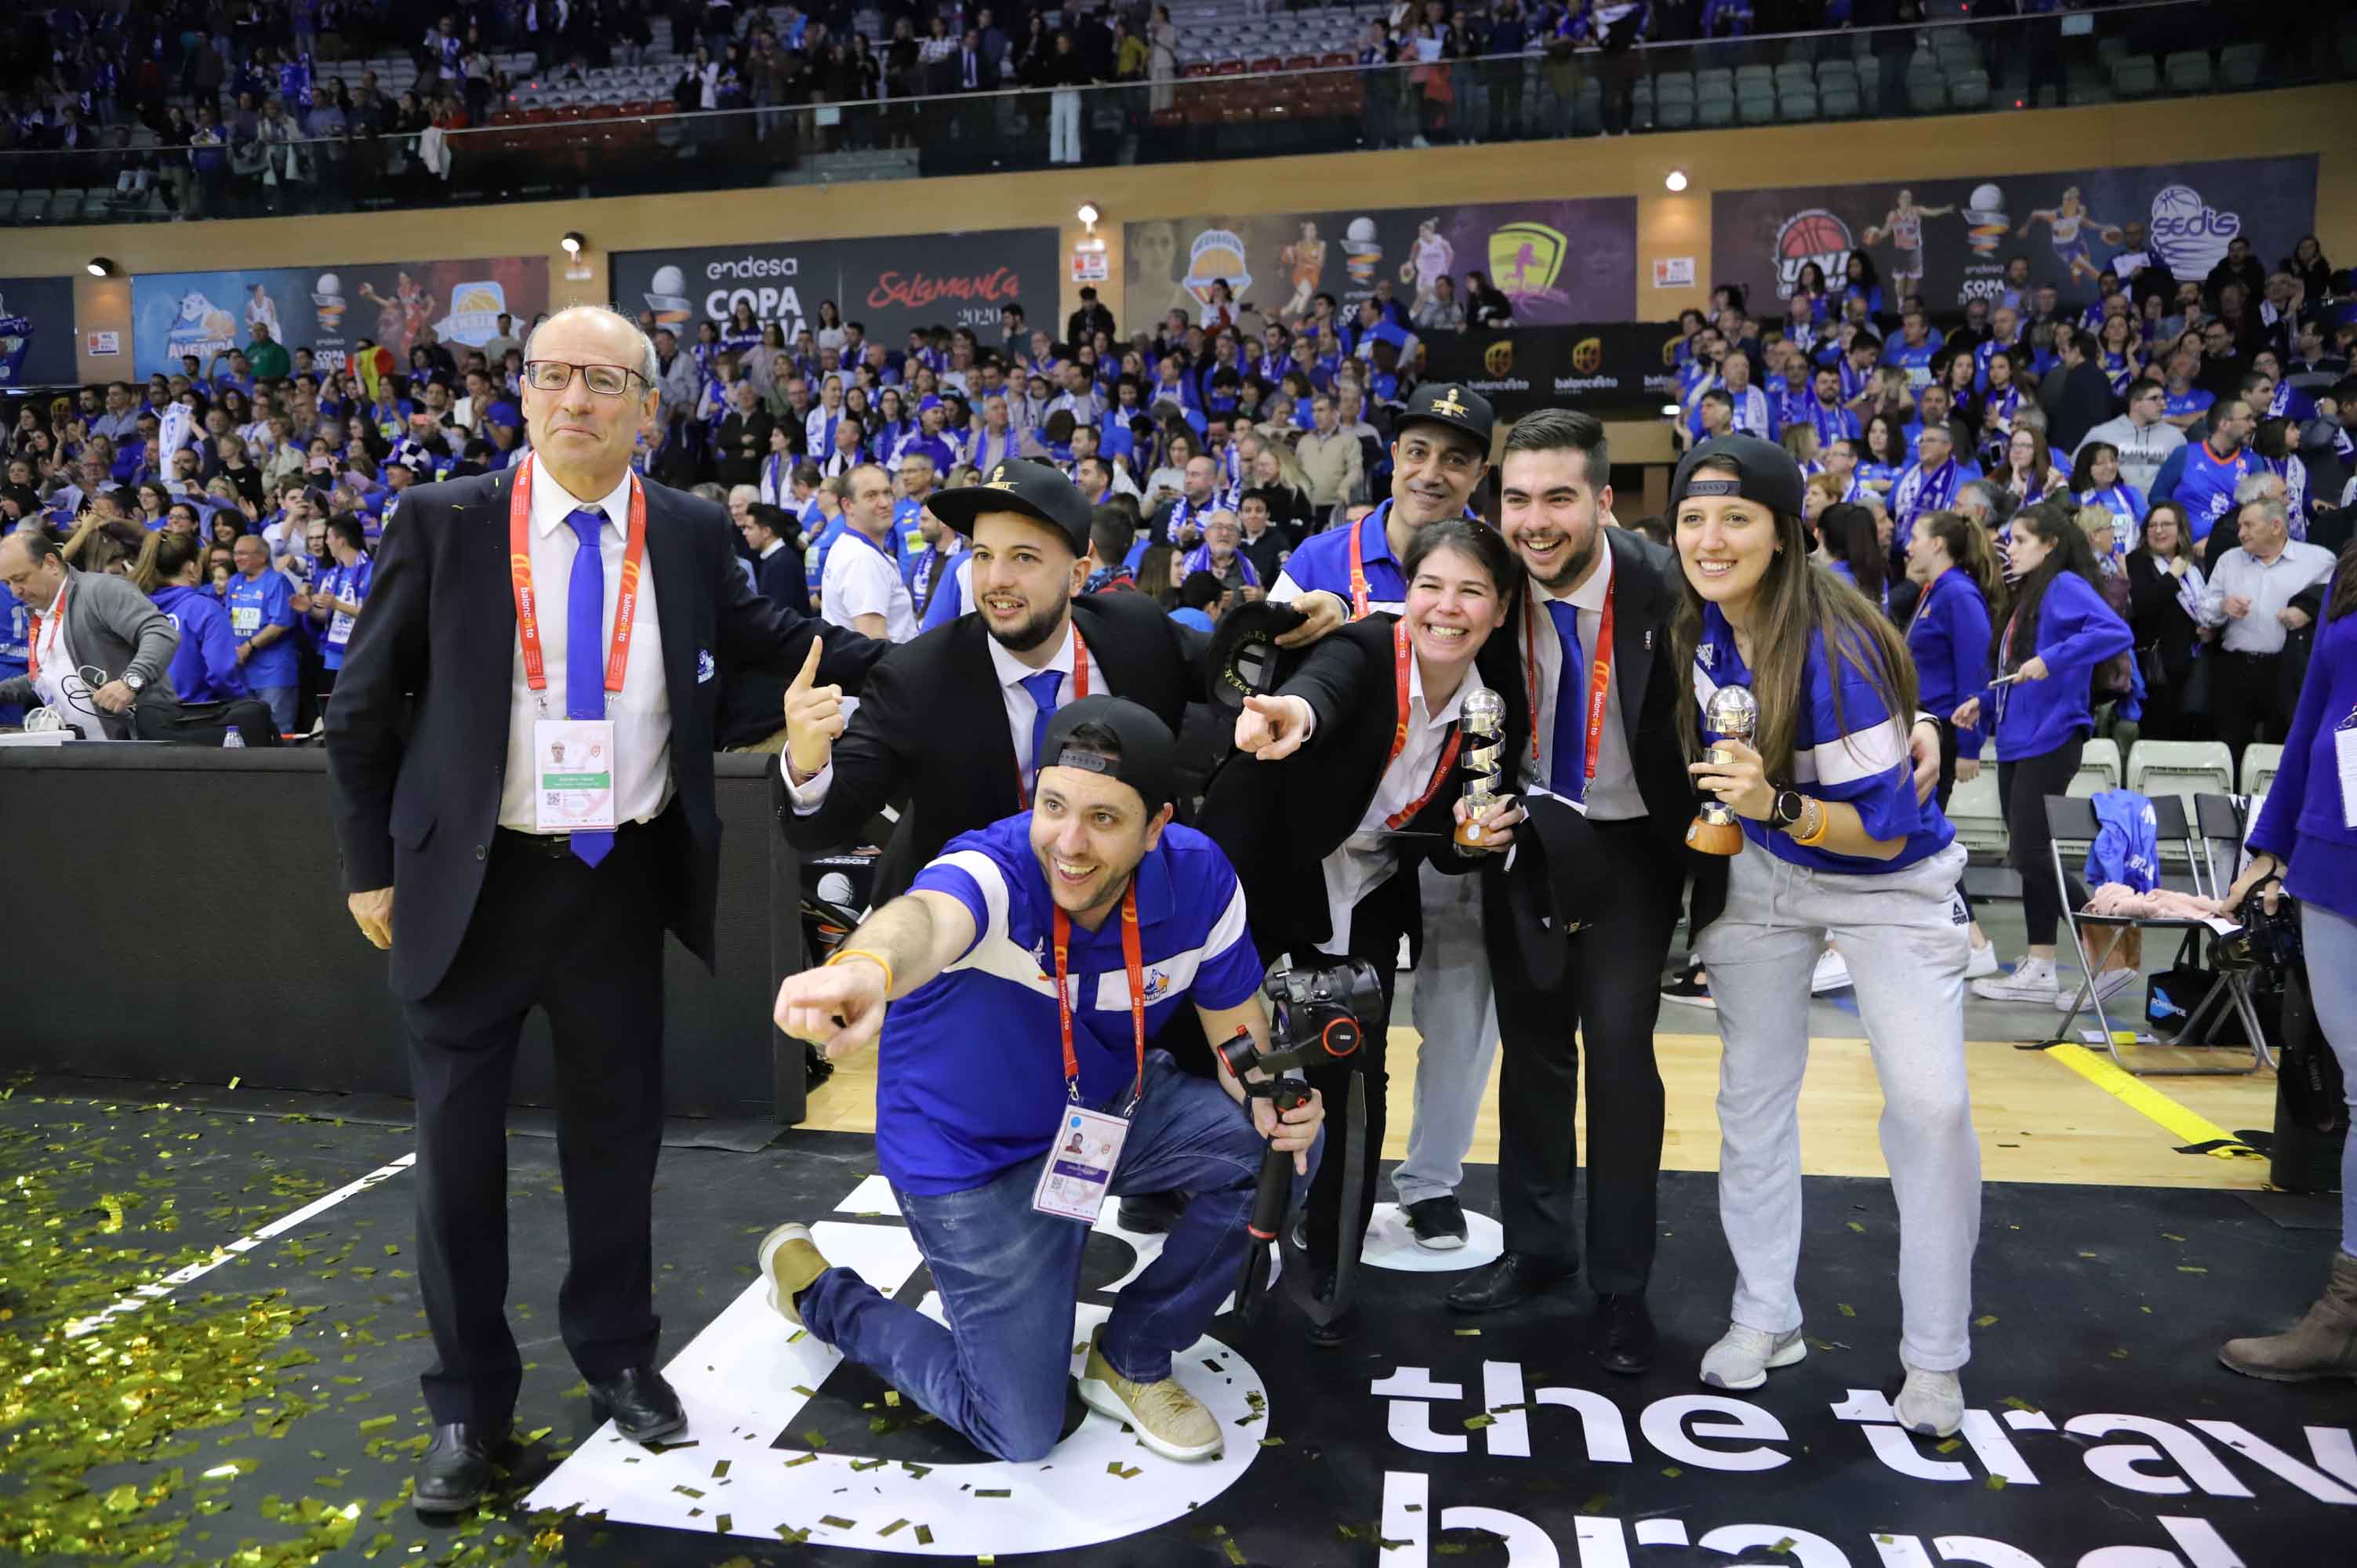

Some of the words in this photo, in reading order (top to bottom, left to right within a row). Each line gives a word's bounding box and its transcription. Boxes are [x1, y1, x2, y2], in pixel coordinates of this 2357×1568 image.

[2153, 207, 2238, 237] sedis
[706, 255, 798, 281] endesa
[706, 285, 804, 322] COPA
[957, 307, 1002, 327] 2020
[520, 586, 534, 639] baloncesto
[617, 593, 633, 642] baloncesto
[1590, 690, 1603, 736] baloncesto
[1370, 1359, 1793, 1471] the
